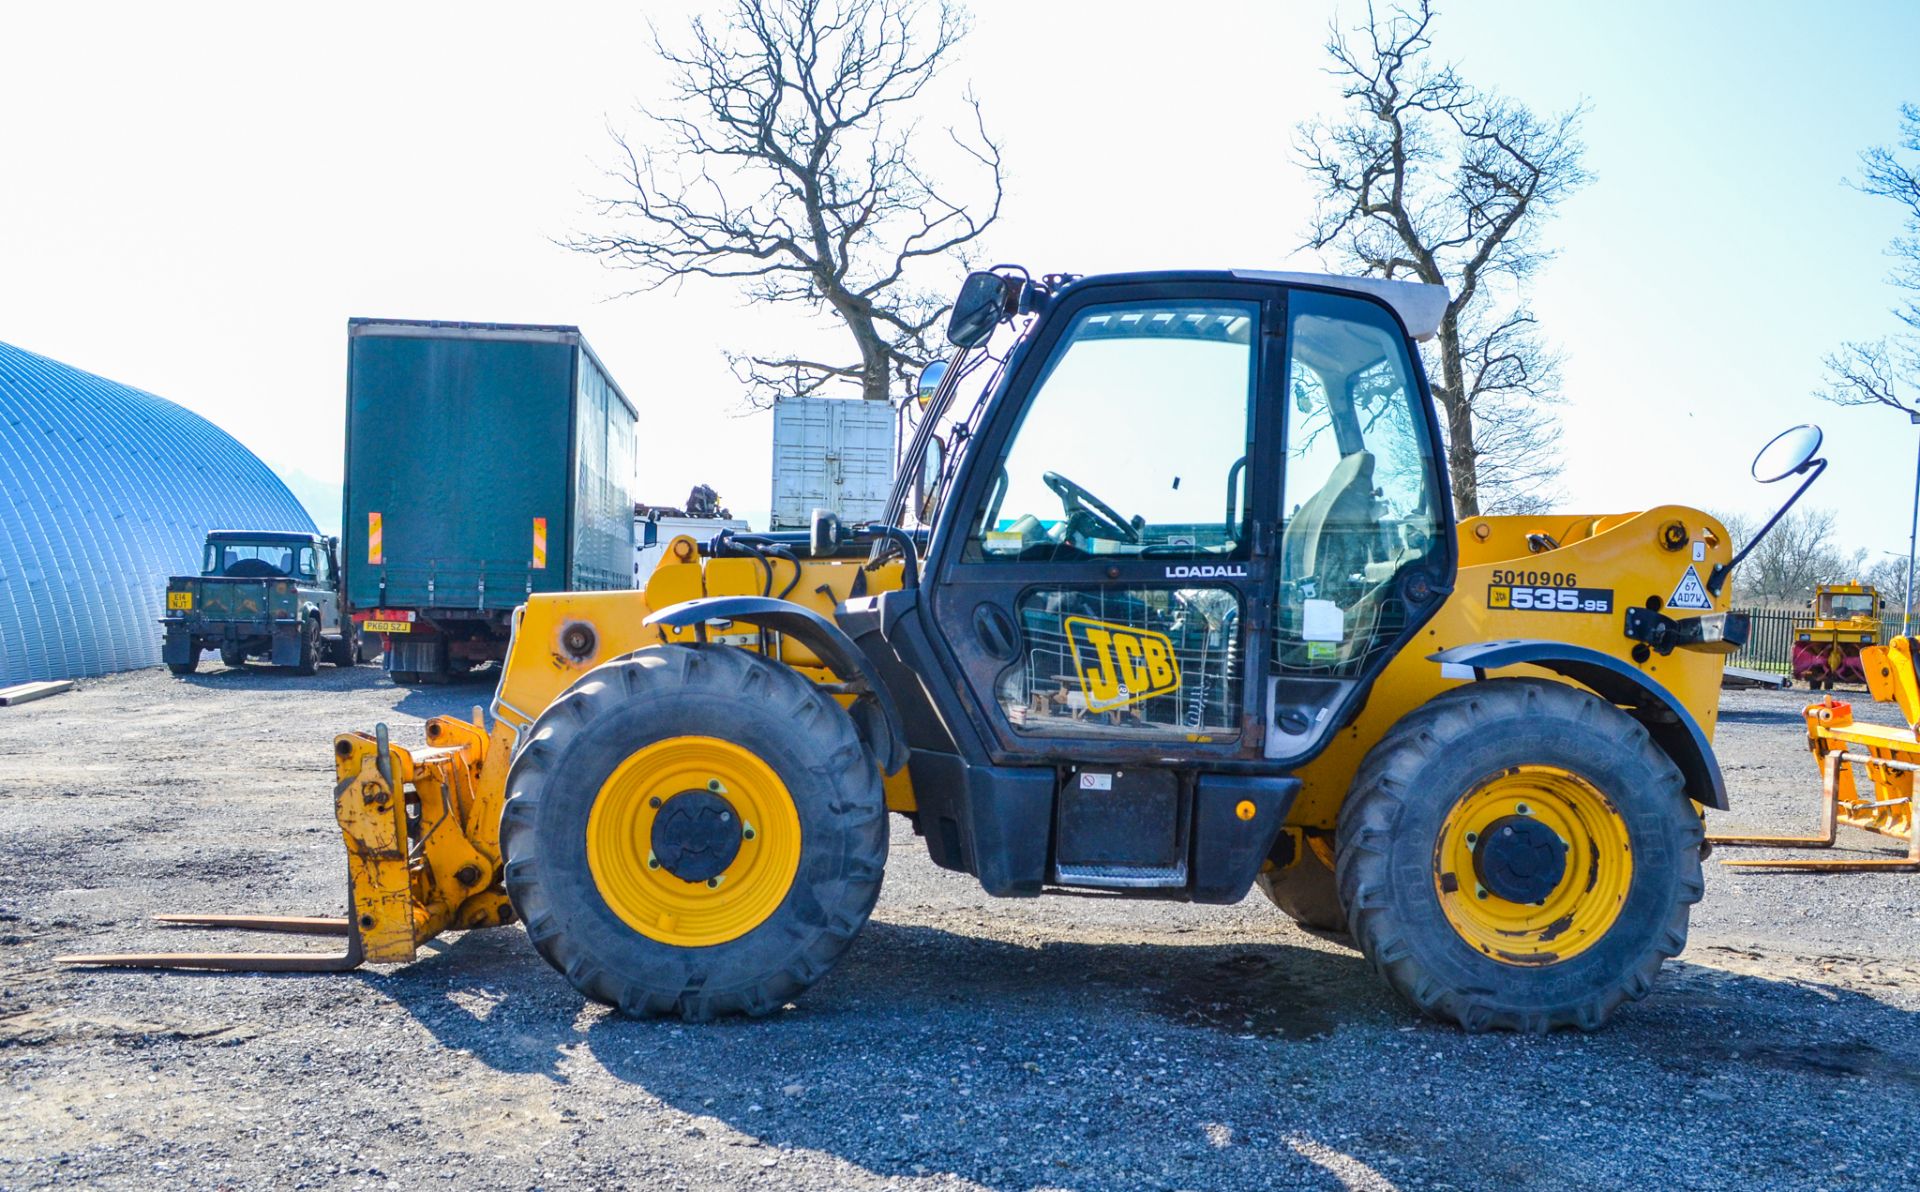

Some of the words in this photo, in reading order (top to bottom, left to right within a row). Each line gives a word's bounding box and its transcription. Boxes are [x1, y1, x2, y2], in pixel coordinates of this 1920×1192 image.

[1165, 566, 1247, 578] LOADALL
[1492, 570, 1577, 587] 5010906
[1685, 582, 1697, 591] 67
[1677, 593, 1702, 603] AD7W
[366, 622, 389, 631] PK60
[390, 623, 408, 631] SZJ
[1085, 628, 1174, 701] JCB
